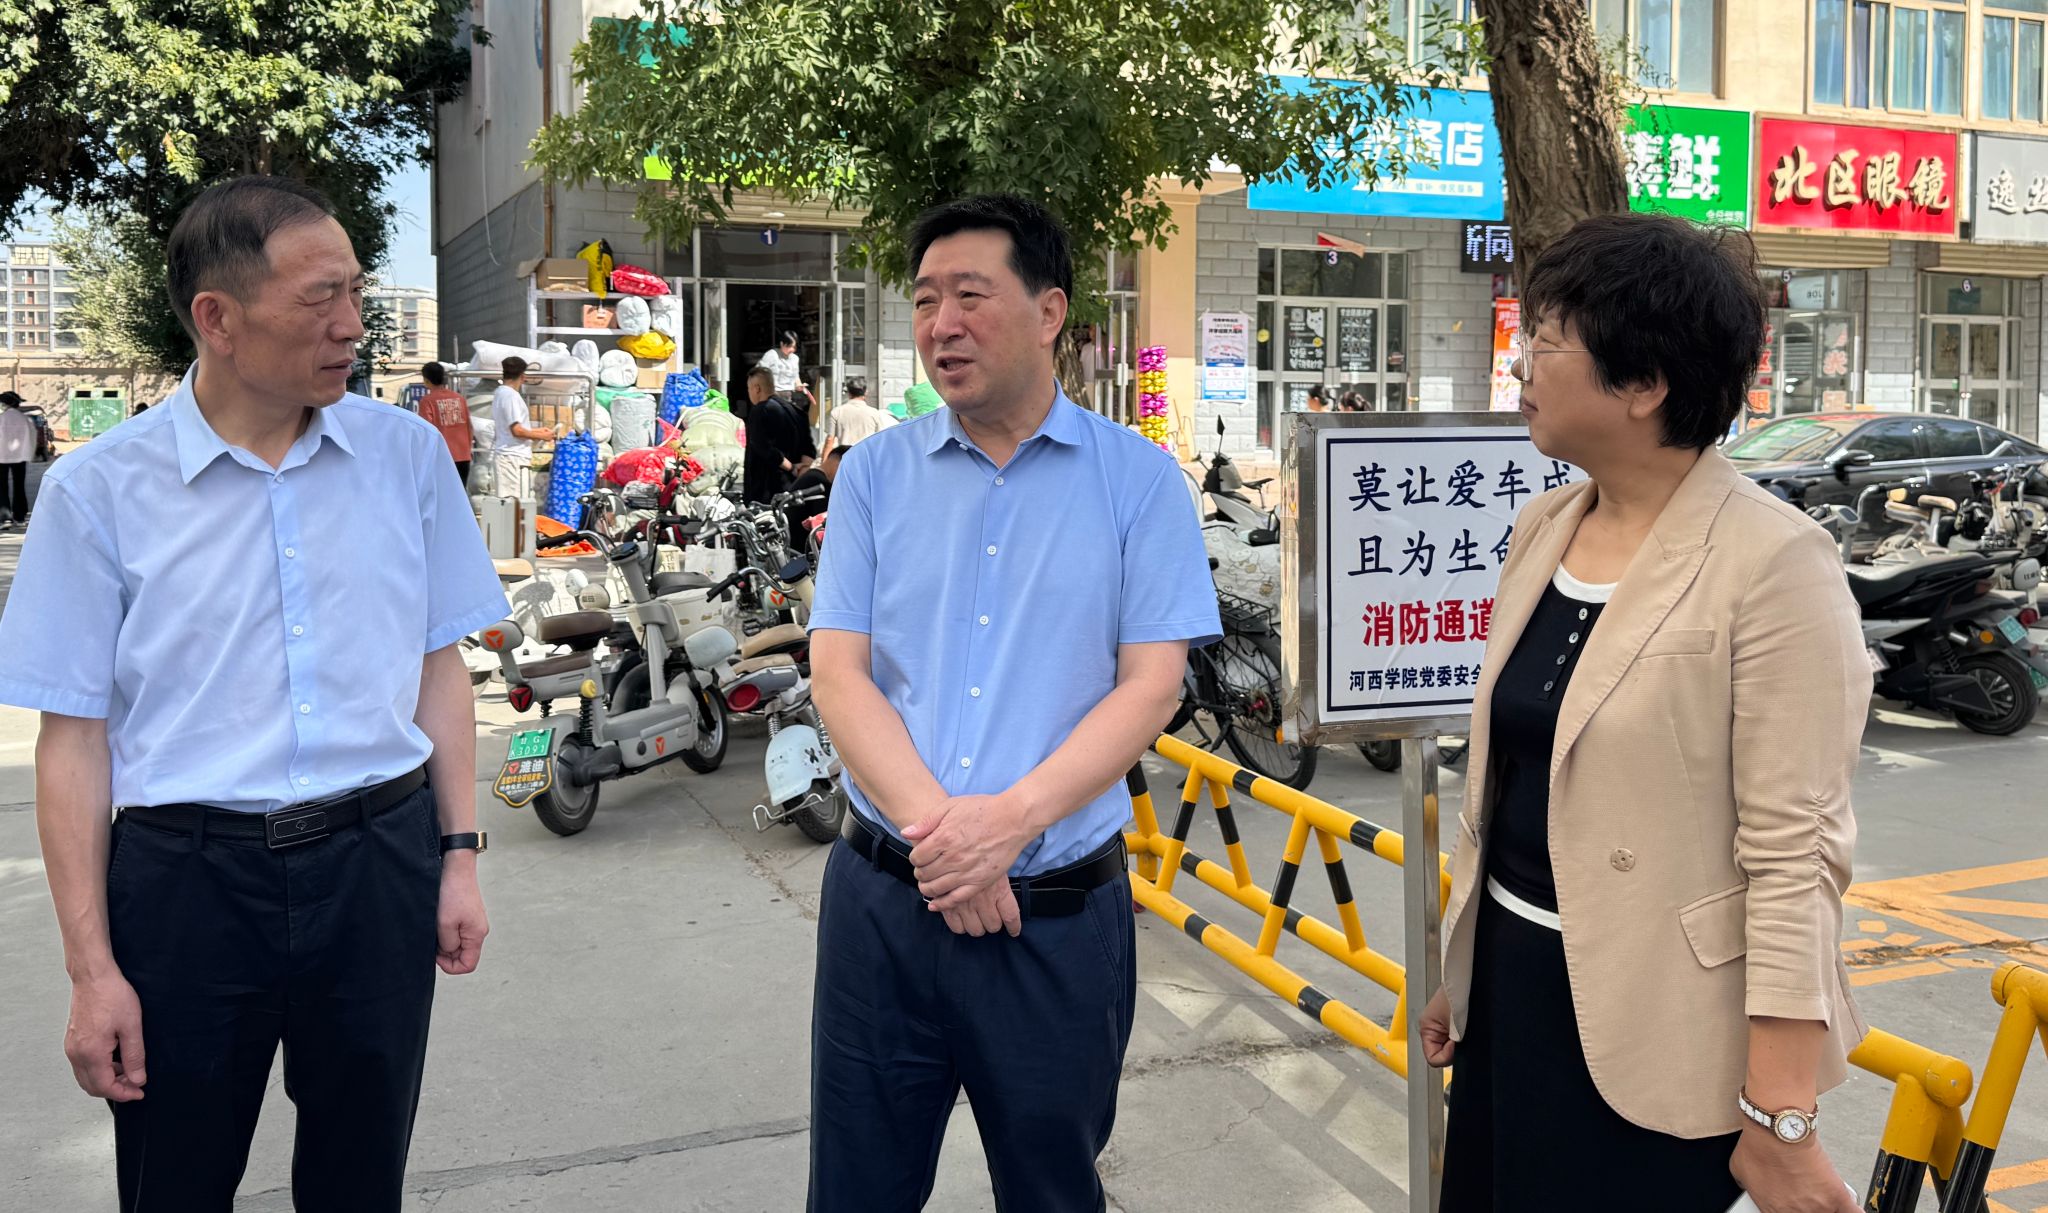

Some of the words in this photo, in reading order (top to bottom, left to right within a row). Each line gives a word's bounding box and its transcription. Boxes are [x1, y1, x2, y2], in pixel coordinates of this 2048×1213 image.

[1768, 145, 1950, 214] 北区眼镜
[763, 229, 773, 245] 1
[1328, 251, 1338, 264] 3
[1783, 270, 1791, 283] 5
[1962, 280, 1971, 292] 6
[1349, 460, 1570, 512] 莫让爱车成
[1362, 598, 1495, 646] 消防通道
